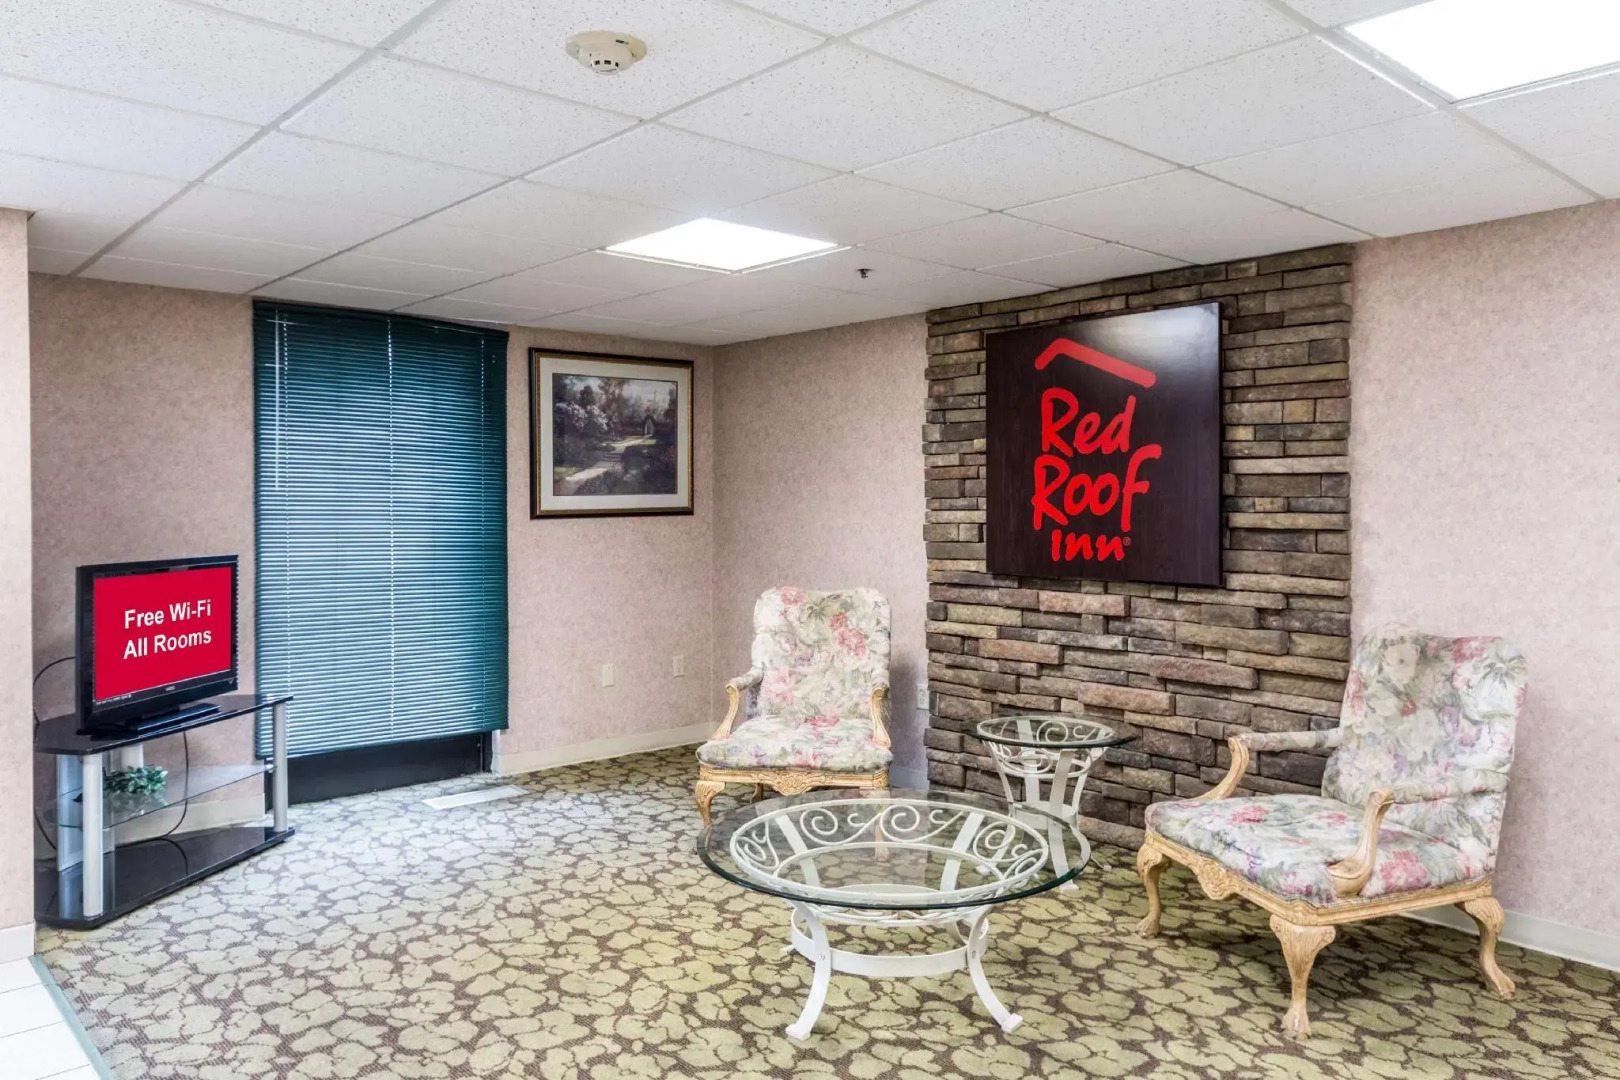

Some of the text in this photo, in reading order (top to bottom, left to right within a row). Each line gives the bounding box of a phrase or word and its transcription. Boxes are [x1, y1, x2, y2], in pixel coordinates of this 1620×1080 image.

[1041, 387, 1137, 457] Red
[1031, 443, 1163, 532] Roof
[124, 599, 212, 630] Free Wi-Fi
[123, 630, 213, 660] All Rooms
